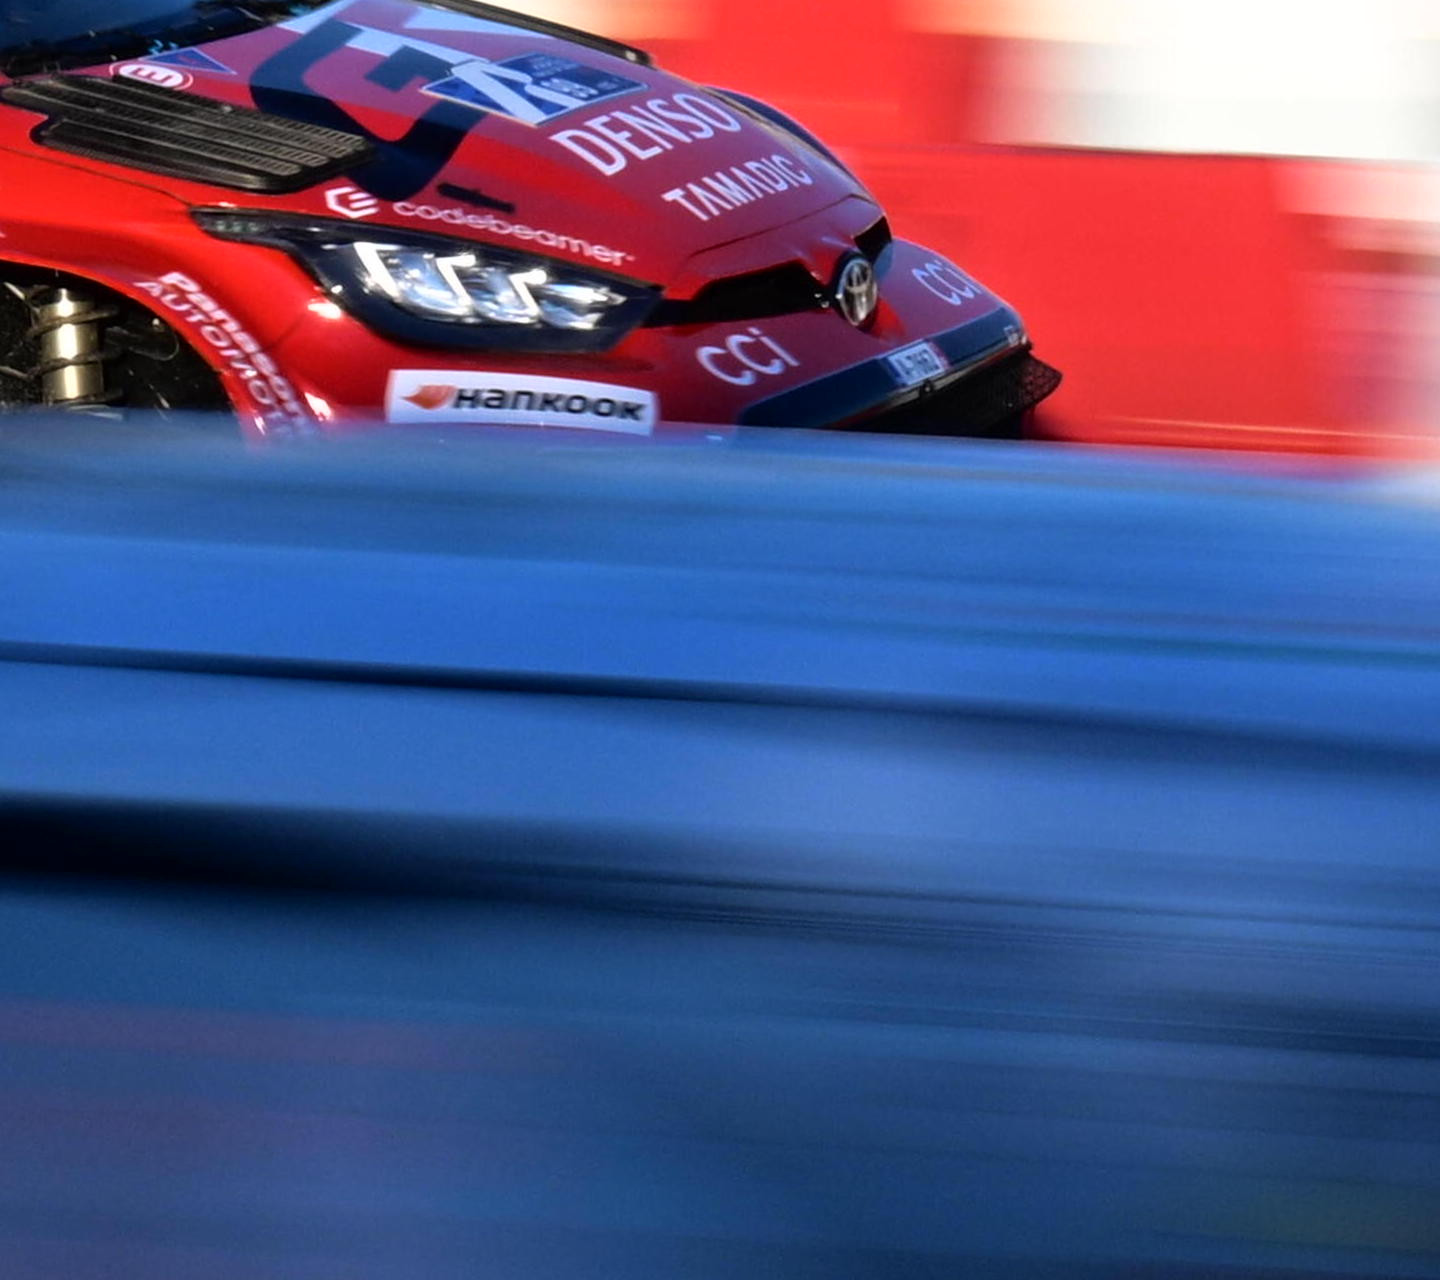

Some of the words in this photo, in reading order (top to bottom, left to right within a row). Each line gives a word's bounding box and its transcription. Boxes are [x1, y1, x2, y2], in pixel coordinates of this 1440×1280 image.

[548, 93, 742, 177] DENSO
[661, 154, 814, 222] TAMADIC
[392, 201, 627, 266] codebeamer
[696, 326, 801, 387] CCi
